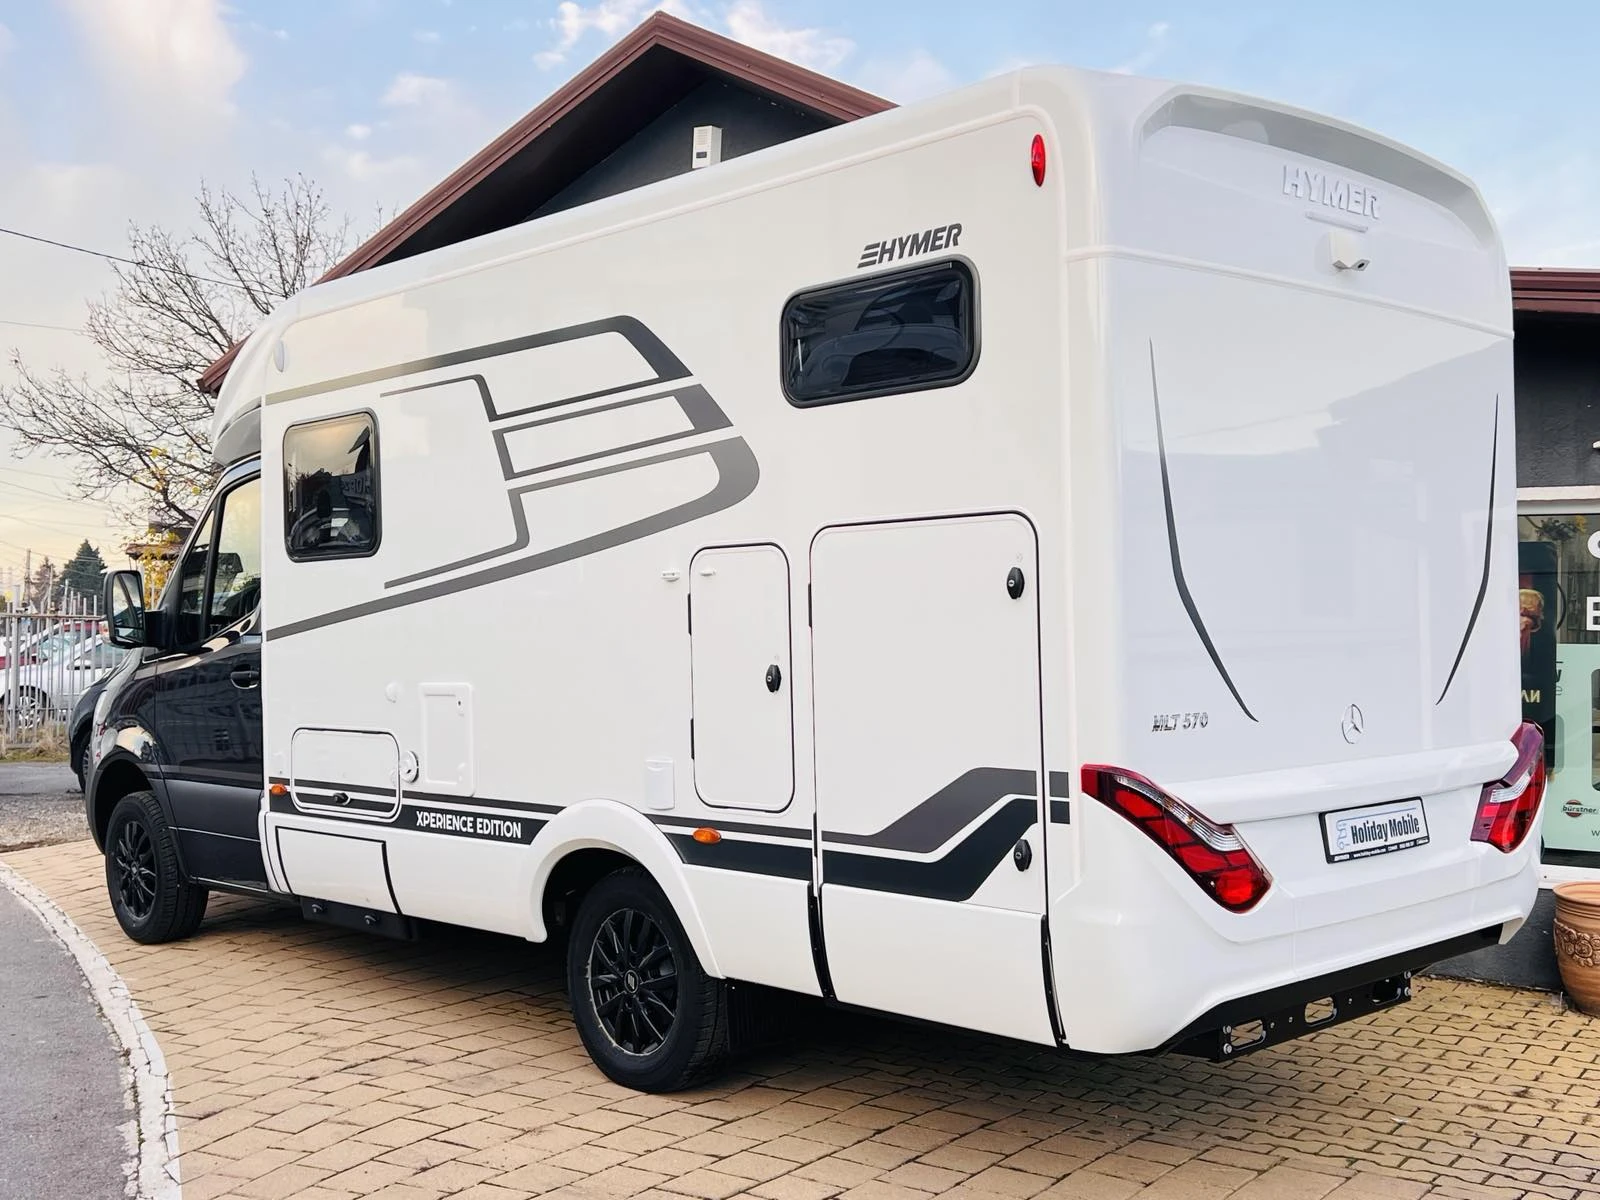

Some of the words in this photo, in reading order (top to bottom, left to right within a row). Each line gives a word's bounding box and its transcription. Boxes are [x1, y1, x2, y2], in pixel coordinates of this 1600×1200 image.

[1282, 165, 1380, 220] HYMER
[1183, 712, 1209, 729] 570
[416, 811, 474, 833] XPERIENCE
[476, 817, 522, 839] EDITION
[1351, 820, 1388, 845] Holiday
[1389, 813, 1420, 838] Mobile
